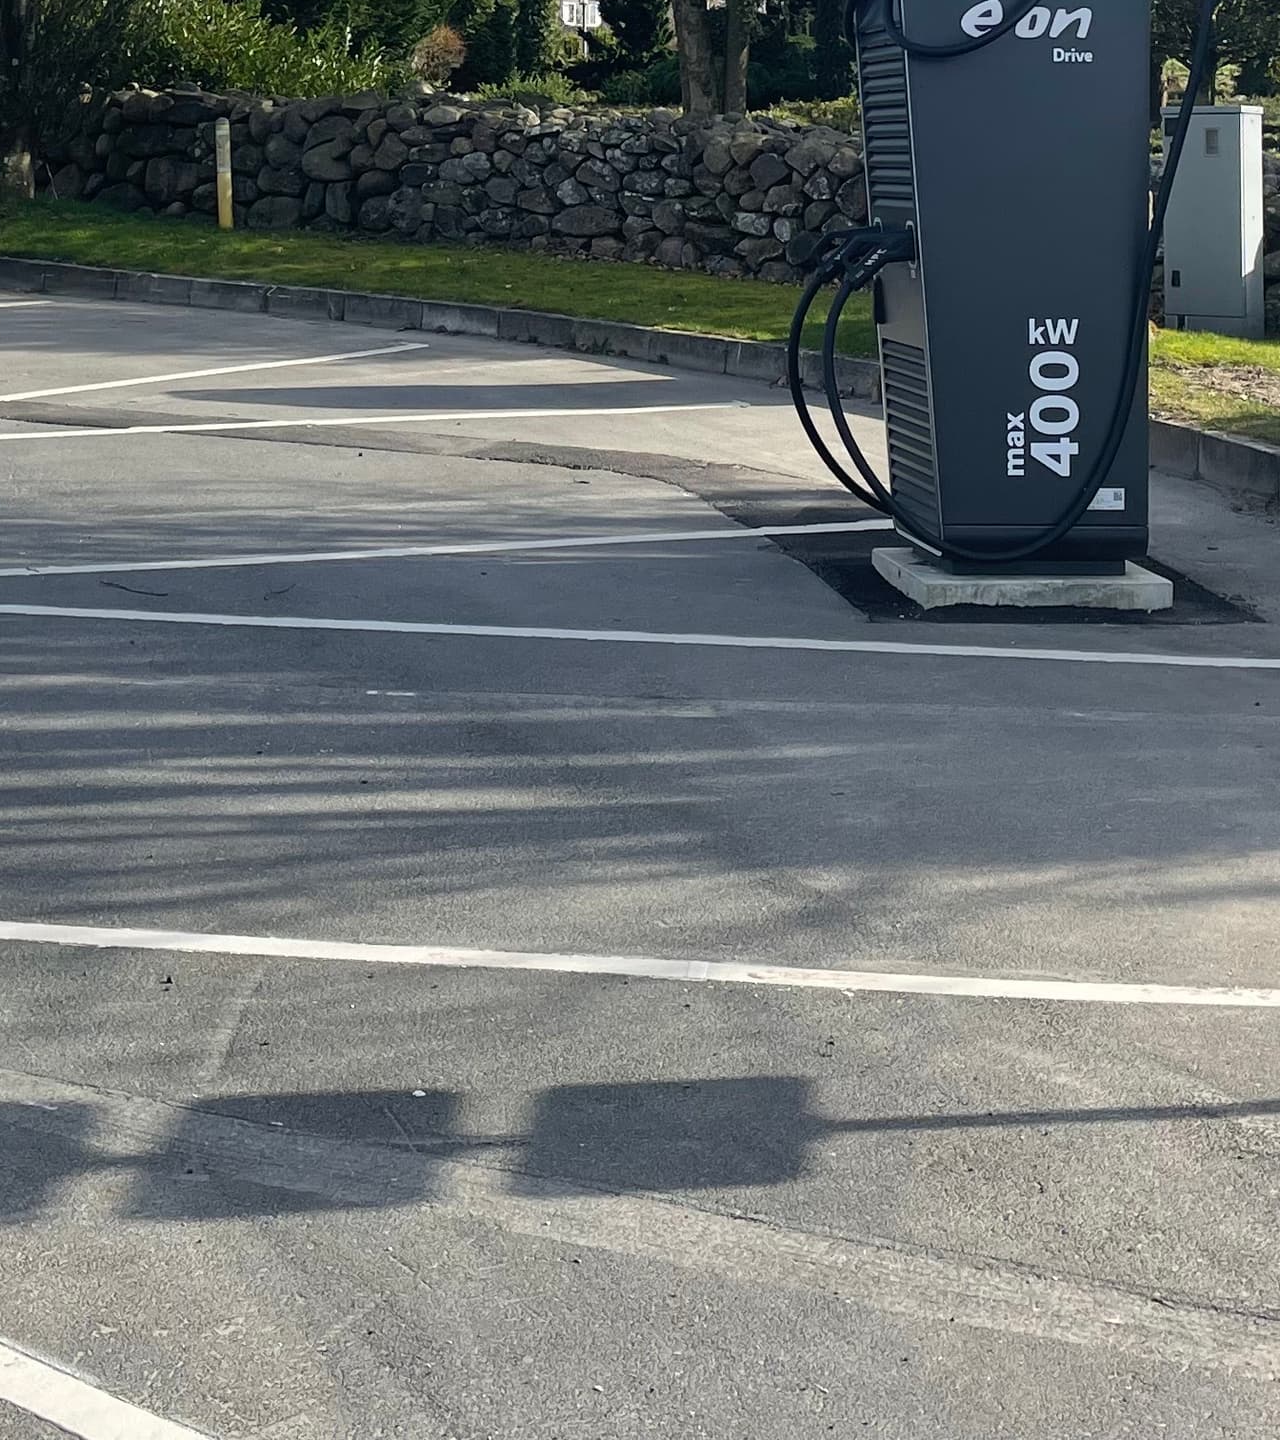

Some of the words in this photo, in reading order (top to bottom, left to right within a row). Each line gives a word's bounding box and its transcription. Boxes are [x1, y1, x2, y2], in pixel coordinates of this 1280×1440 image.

[1052, 47, 1093, 63] Drive
[1028, 318, 1079, 345] kW
[1029, 351, 1079, 477] 400
[1007, 412, 1025, 476] max
